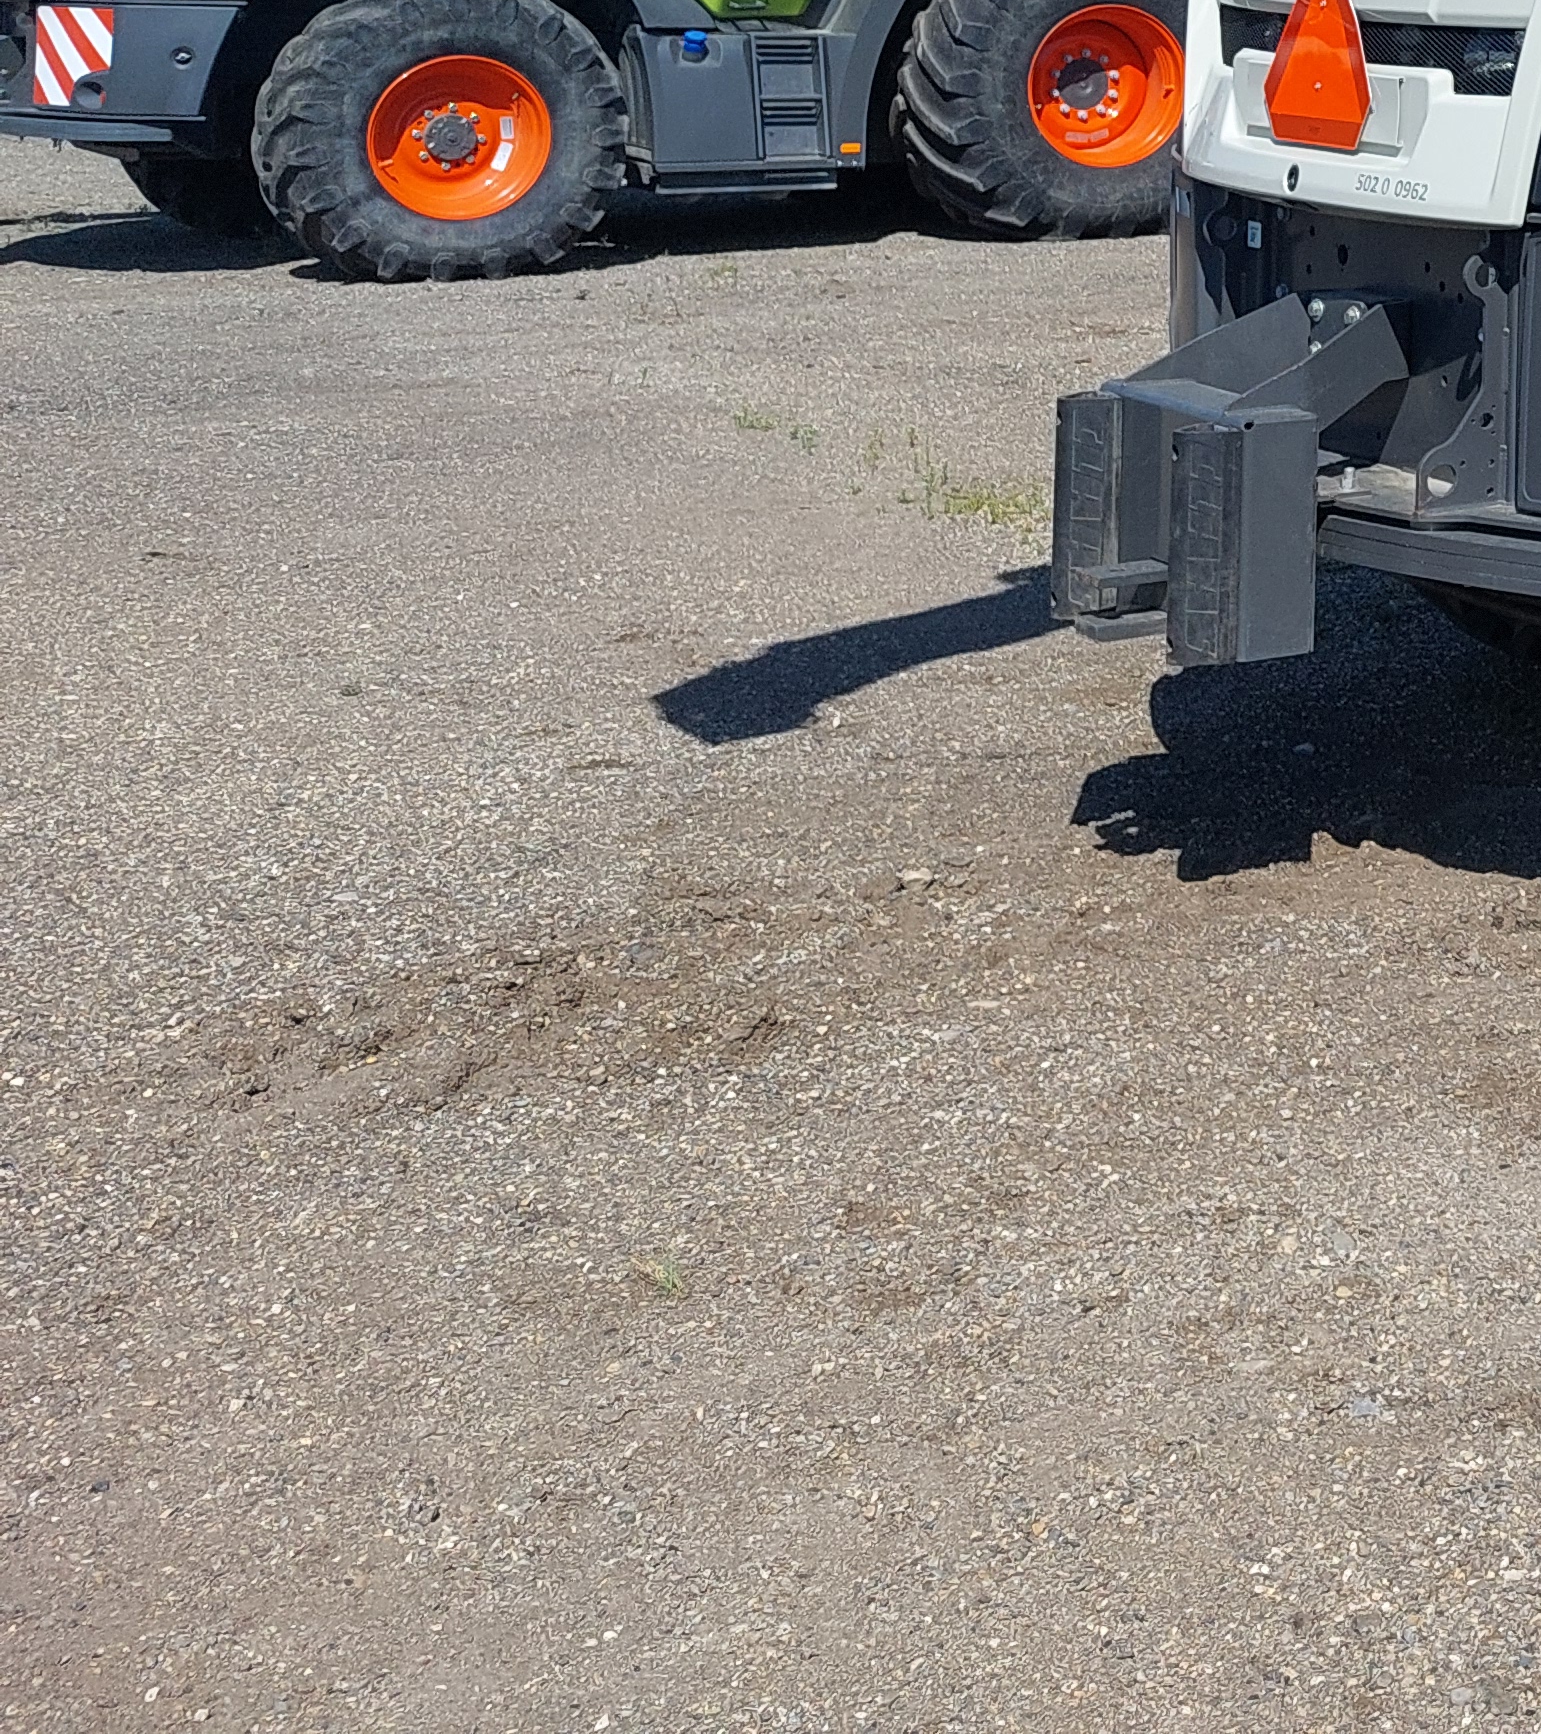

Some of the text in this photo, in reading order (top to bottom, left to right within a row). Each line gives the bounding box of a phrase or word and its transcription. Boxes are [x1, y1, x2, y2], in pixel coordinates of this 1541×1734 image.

[1355, 173, 1429, 202] 502 0 0962
